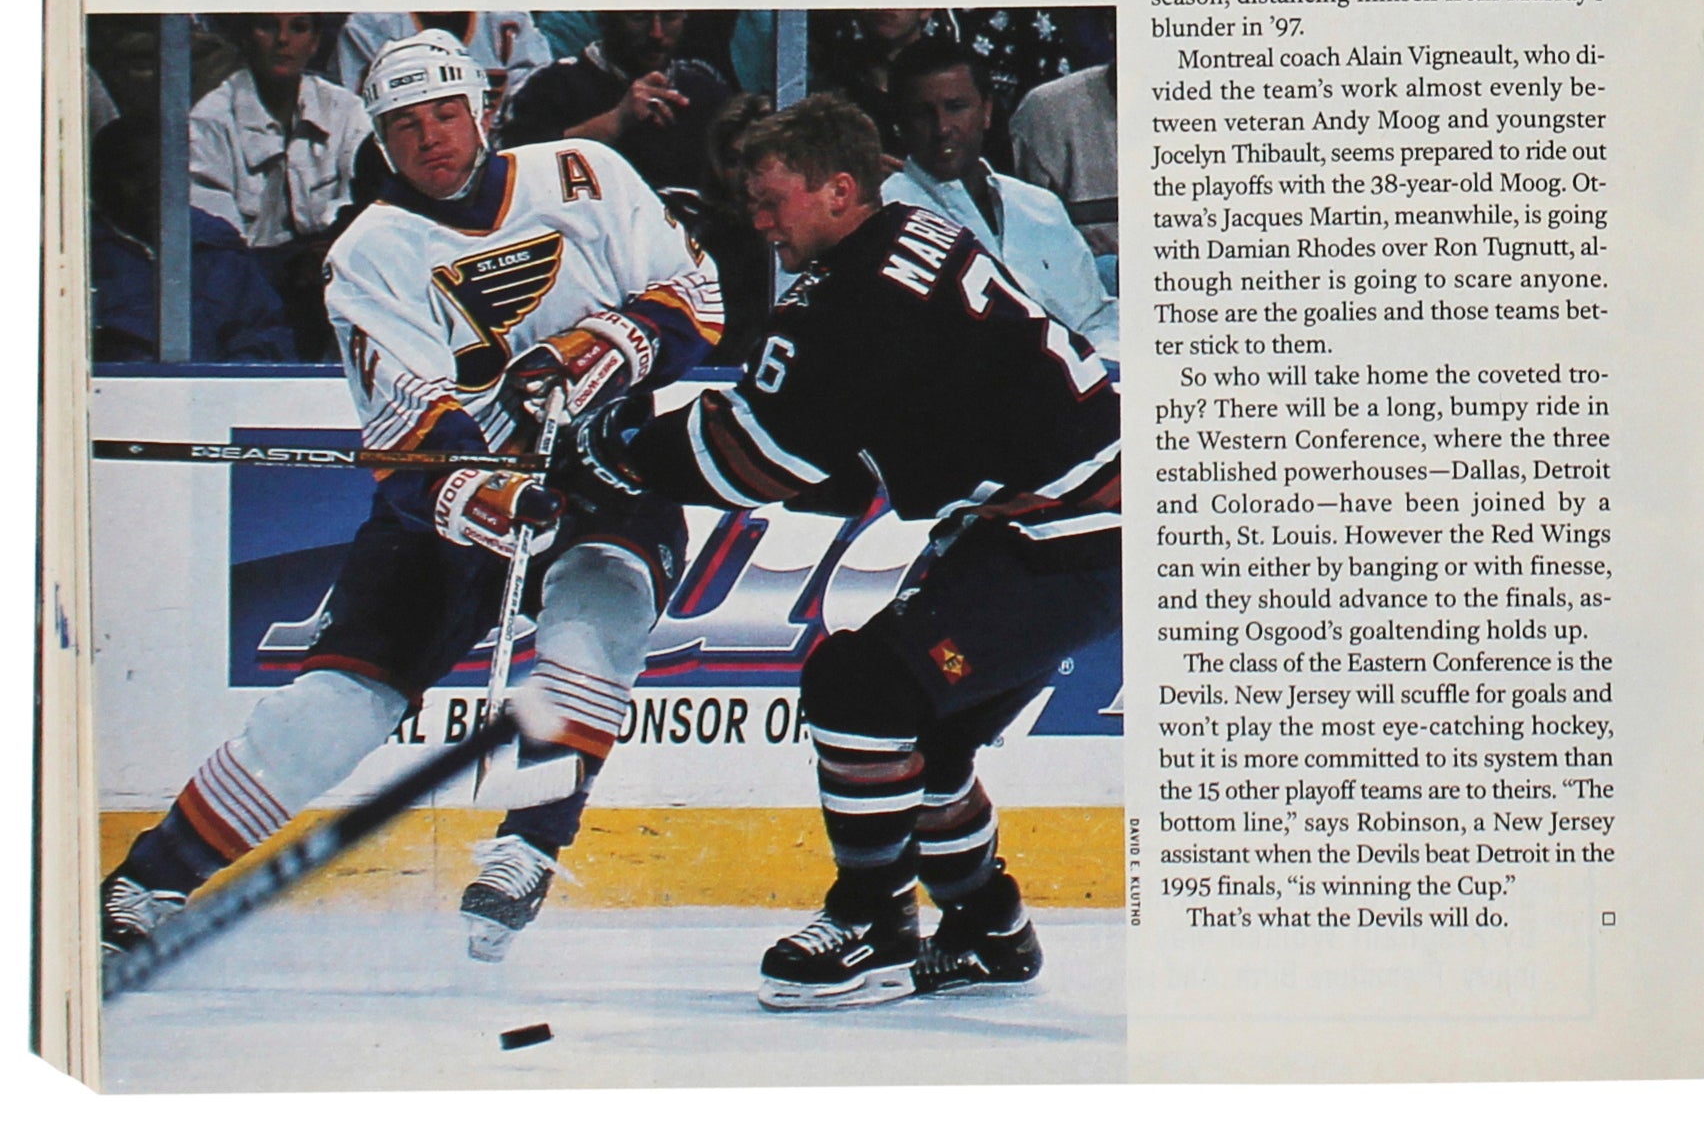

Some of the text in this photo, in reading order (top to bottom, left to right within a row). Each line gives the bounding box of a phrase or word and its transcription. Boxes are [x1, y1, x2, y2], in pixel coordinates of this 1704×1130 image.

[1179, 44, 1604, 70] Montreal coach Alain Vigneault, who di-
[556, 148, 603, 203] A
[499, 251, 531, 267] LOUIS
[221, 447, 356, 462] EASTON
[1130, 818, 1140, 856] DAVID
[1130, 876, 1141, 927] KLUTHO
[1186, 907, 1508, 927] That's what the Devils will do.
